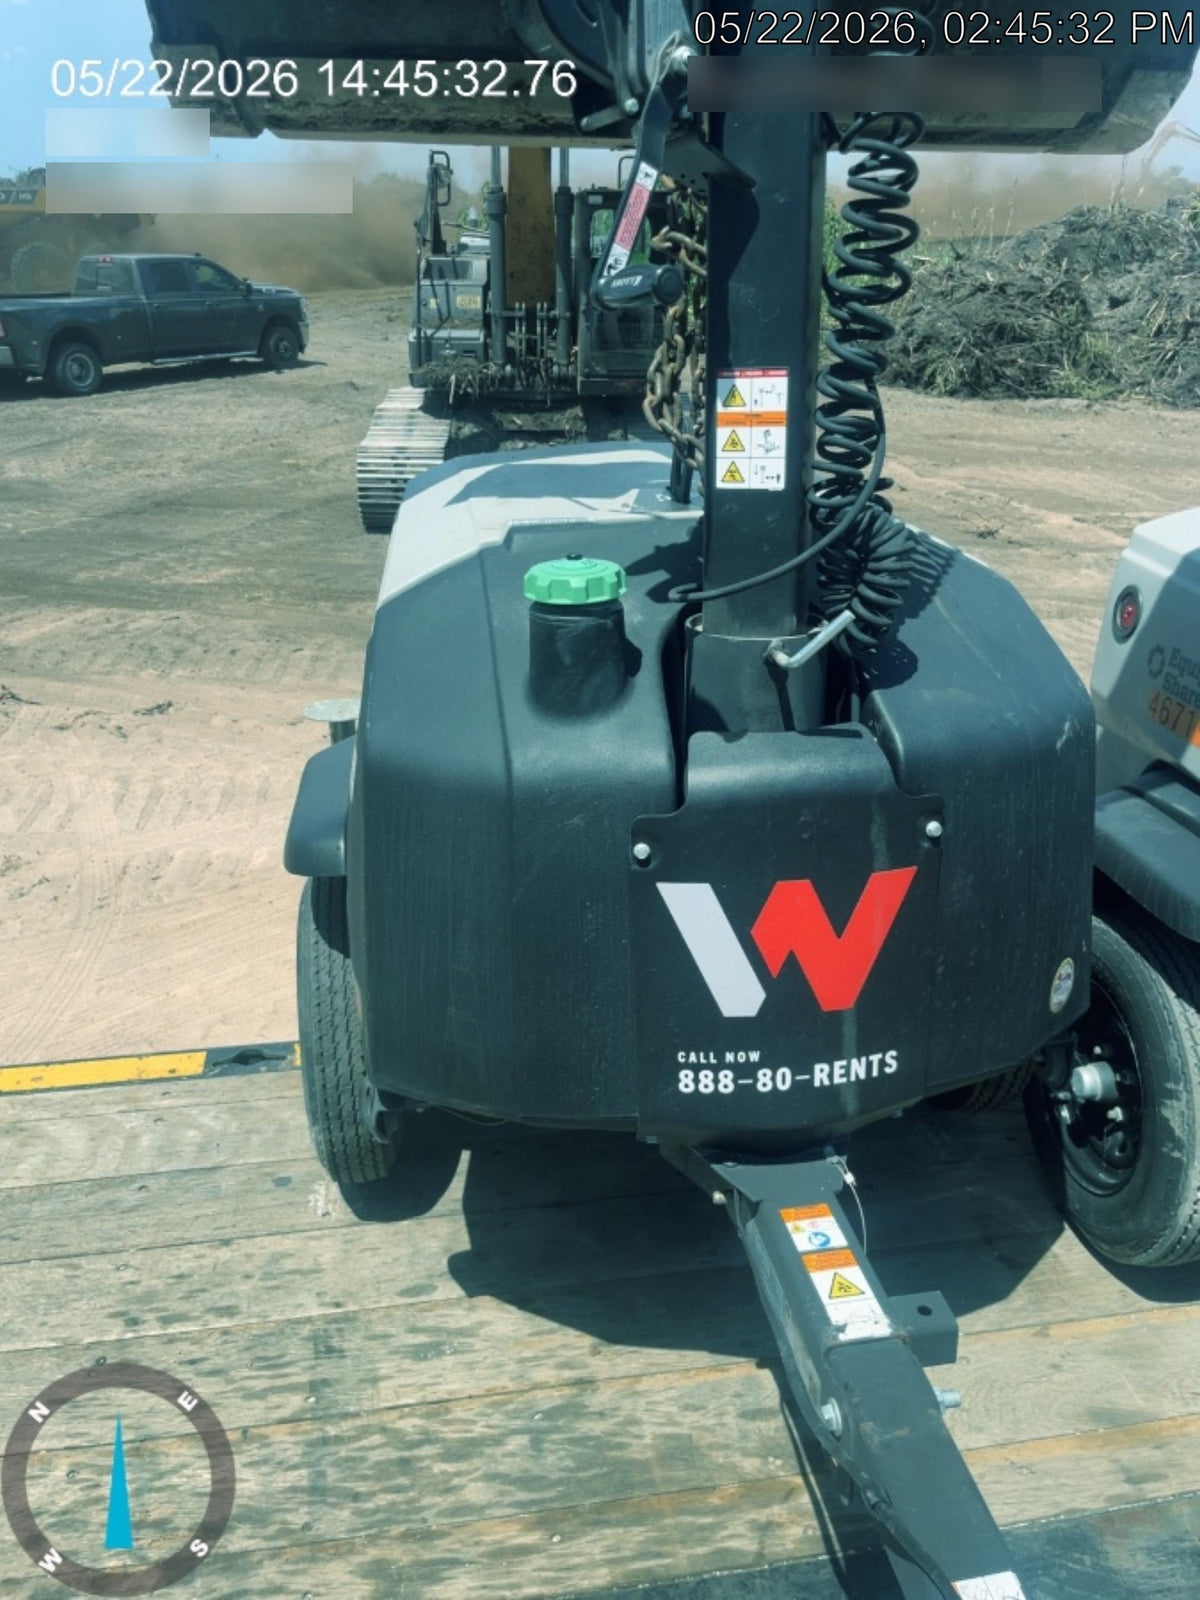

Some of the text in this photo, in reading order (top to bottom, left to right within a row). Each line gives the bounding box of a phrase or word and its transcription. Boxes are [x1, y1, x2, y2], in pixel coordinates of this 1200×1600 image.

[677, 1050, 761, 1064] CALL NOW
[677, 1050, 899, 1094] 888-80-RENTS
